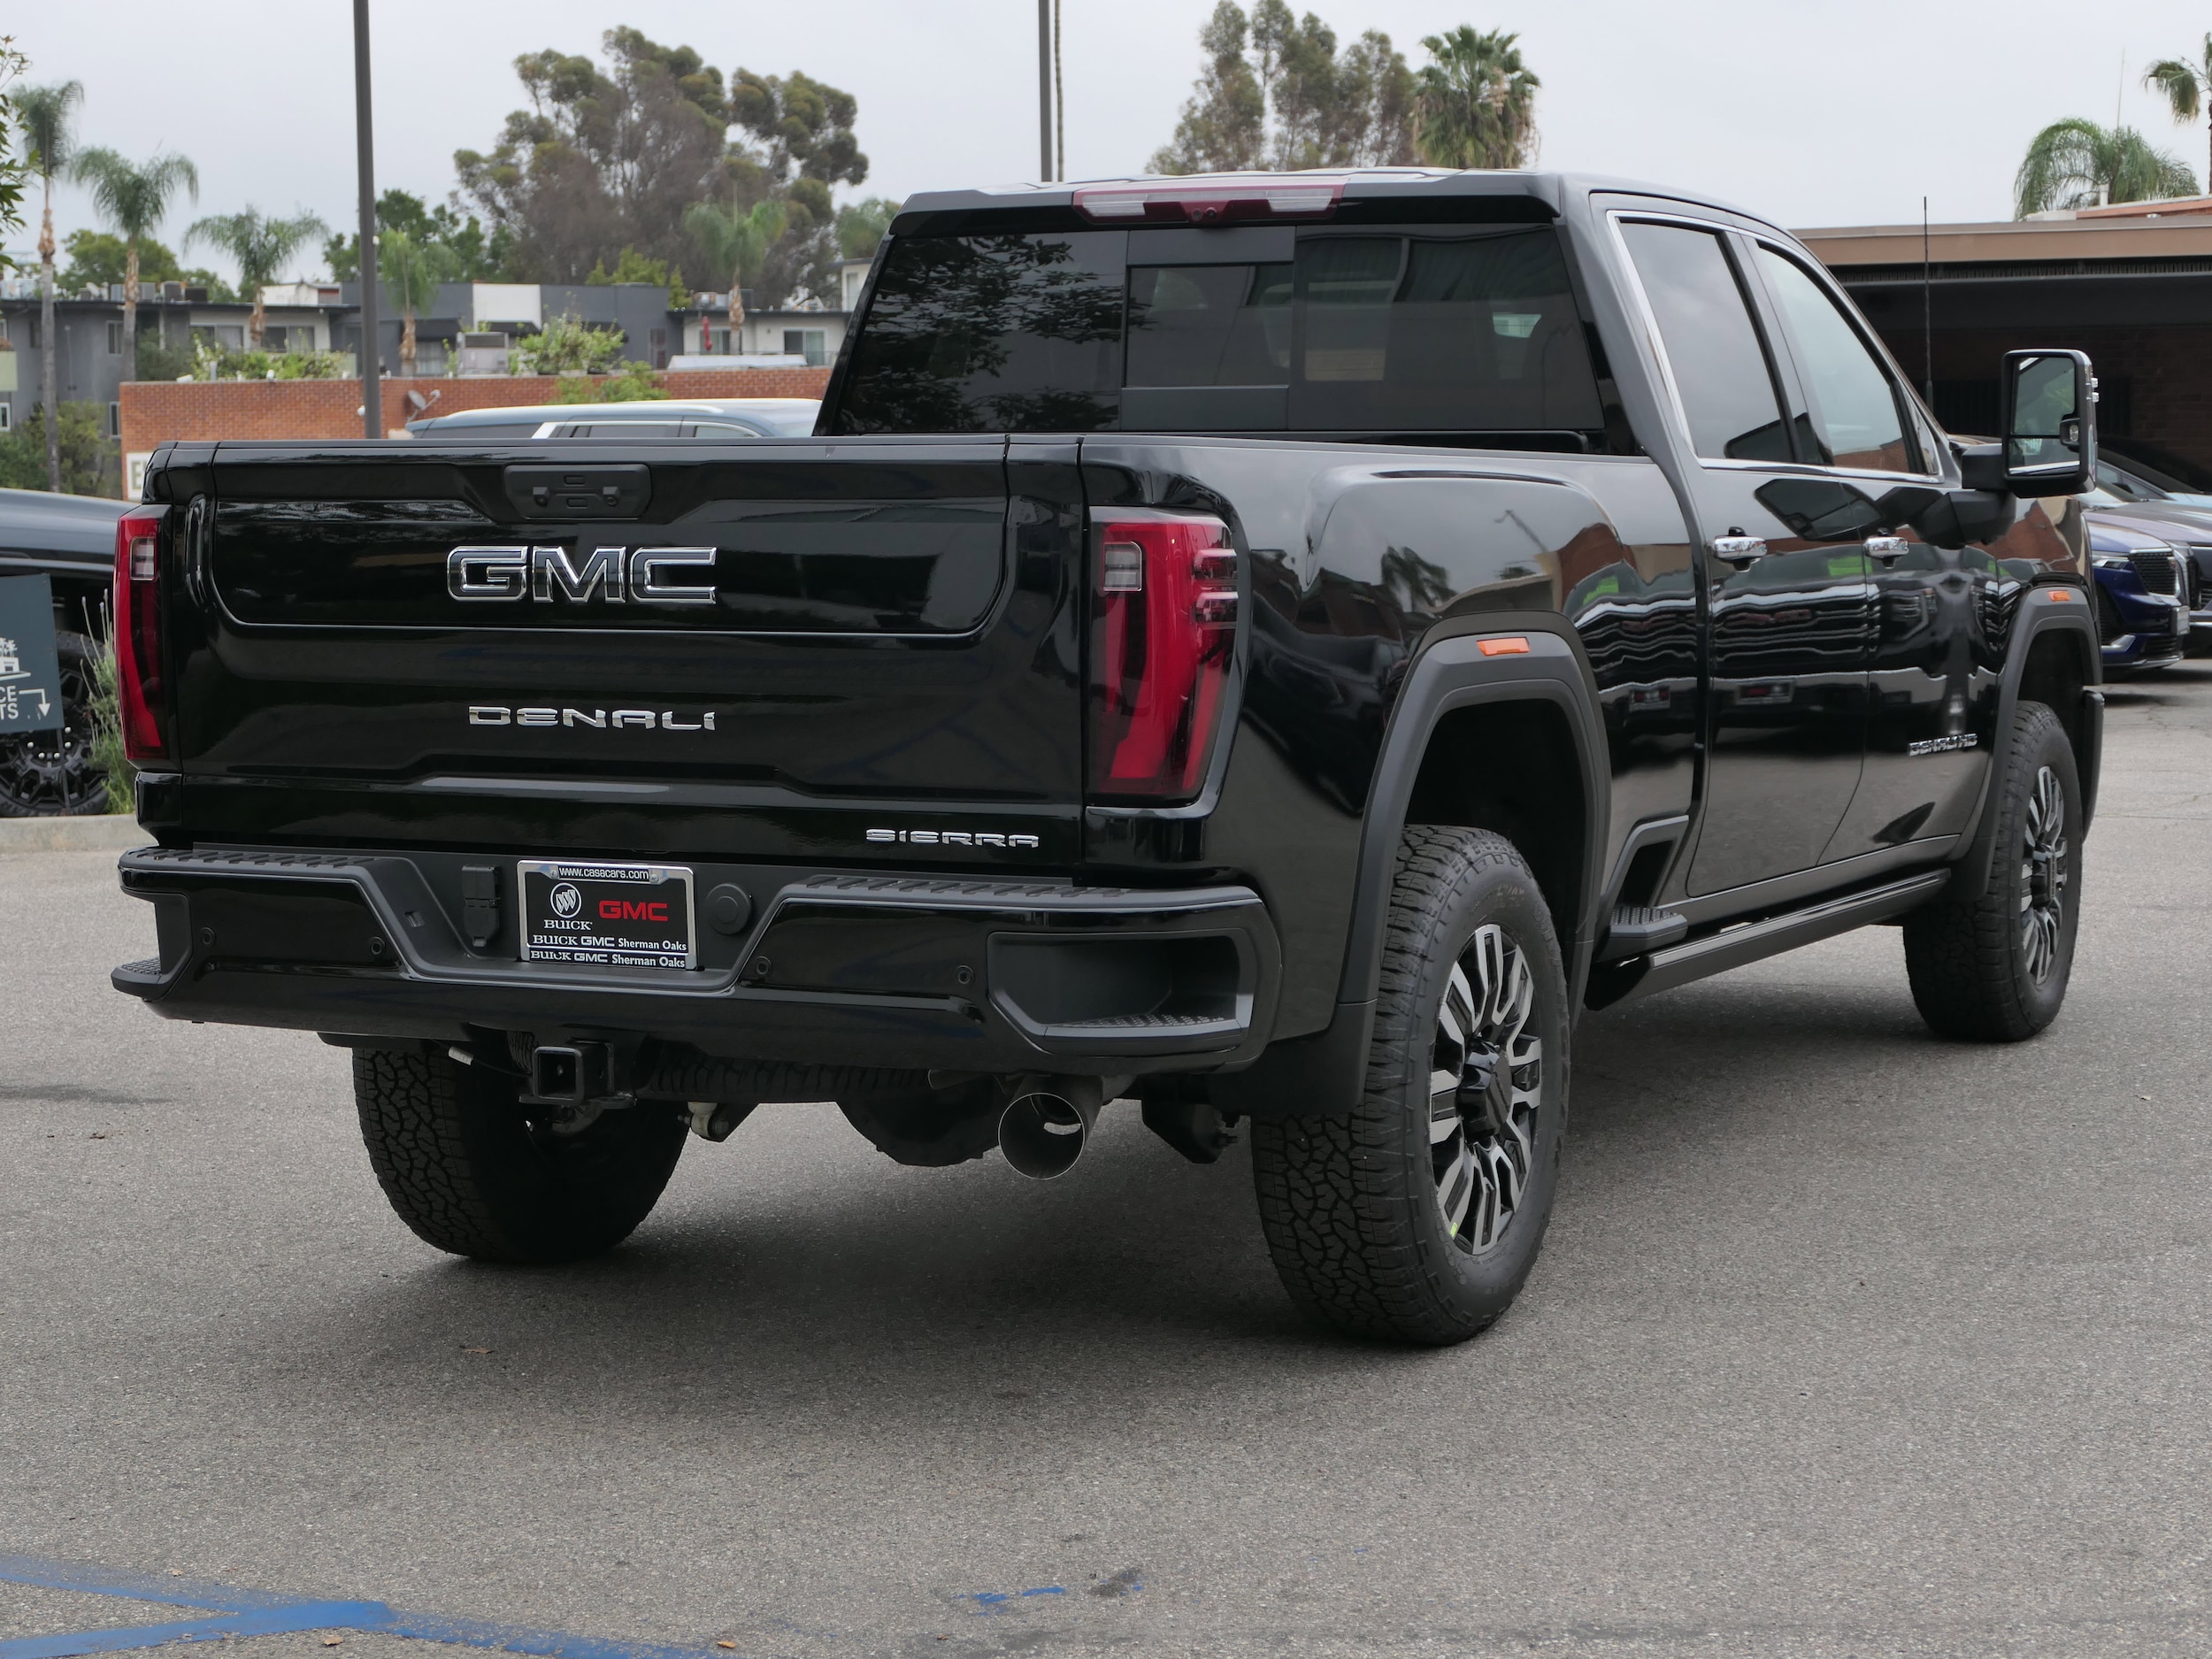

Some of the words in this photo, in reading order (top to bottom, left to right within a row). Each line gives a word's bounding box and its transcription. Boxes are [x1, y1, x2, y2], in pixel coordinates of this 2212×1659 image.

[447, 545, 717, 604] GMC
[469, 706, 716, 731] DENALI
[866, 829, 1040, 849] SIERRA
[558, 867, 649, 880] www.casacars.com
[598, 900, 668, 921] GMC
[544, 919, 592, 931] BUICK
[533, 934, 579, 946] BUICK
[580, 936, 615, 947] GMC
[618, 938, 659, 949] Sherman
[663, 941, 687, 951] Oaks
[530, 950, 572, 961] BUICK
[574, 952, 608, 963] GMC
[611, 954, 657, 967] Sherman
[659, 956, 685, 968] Oaks
